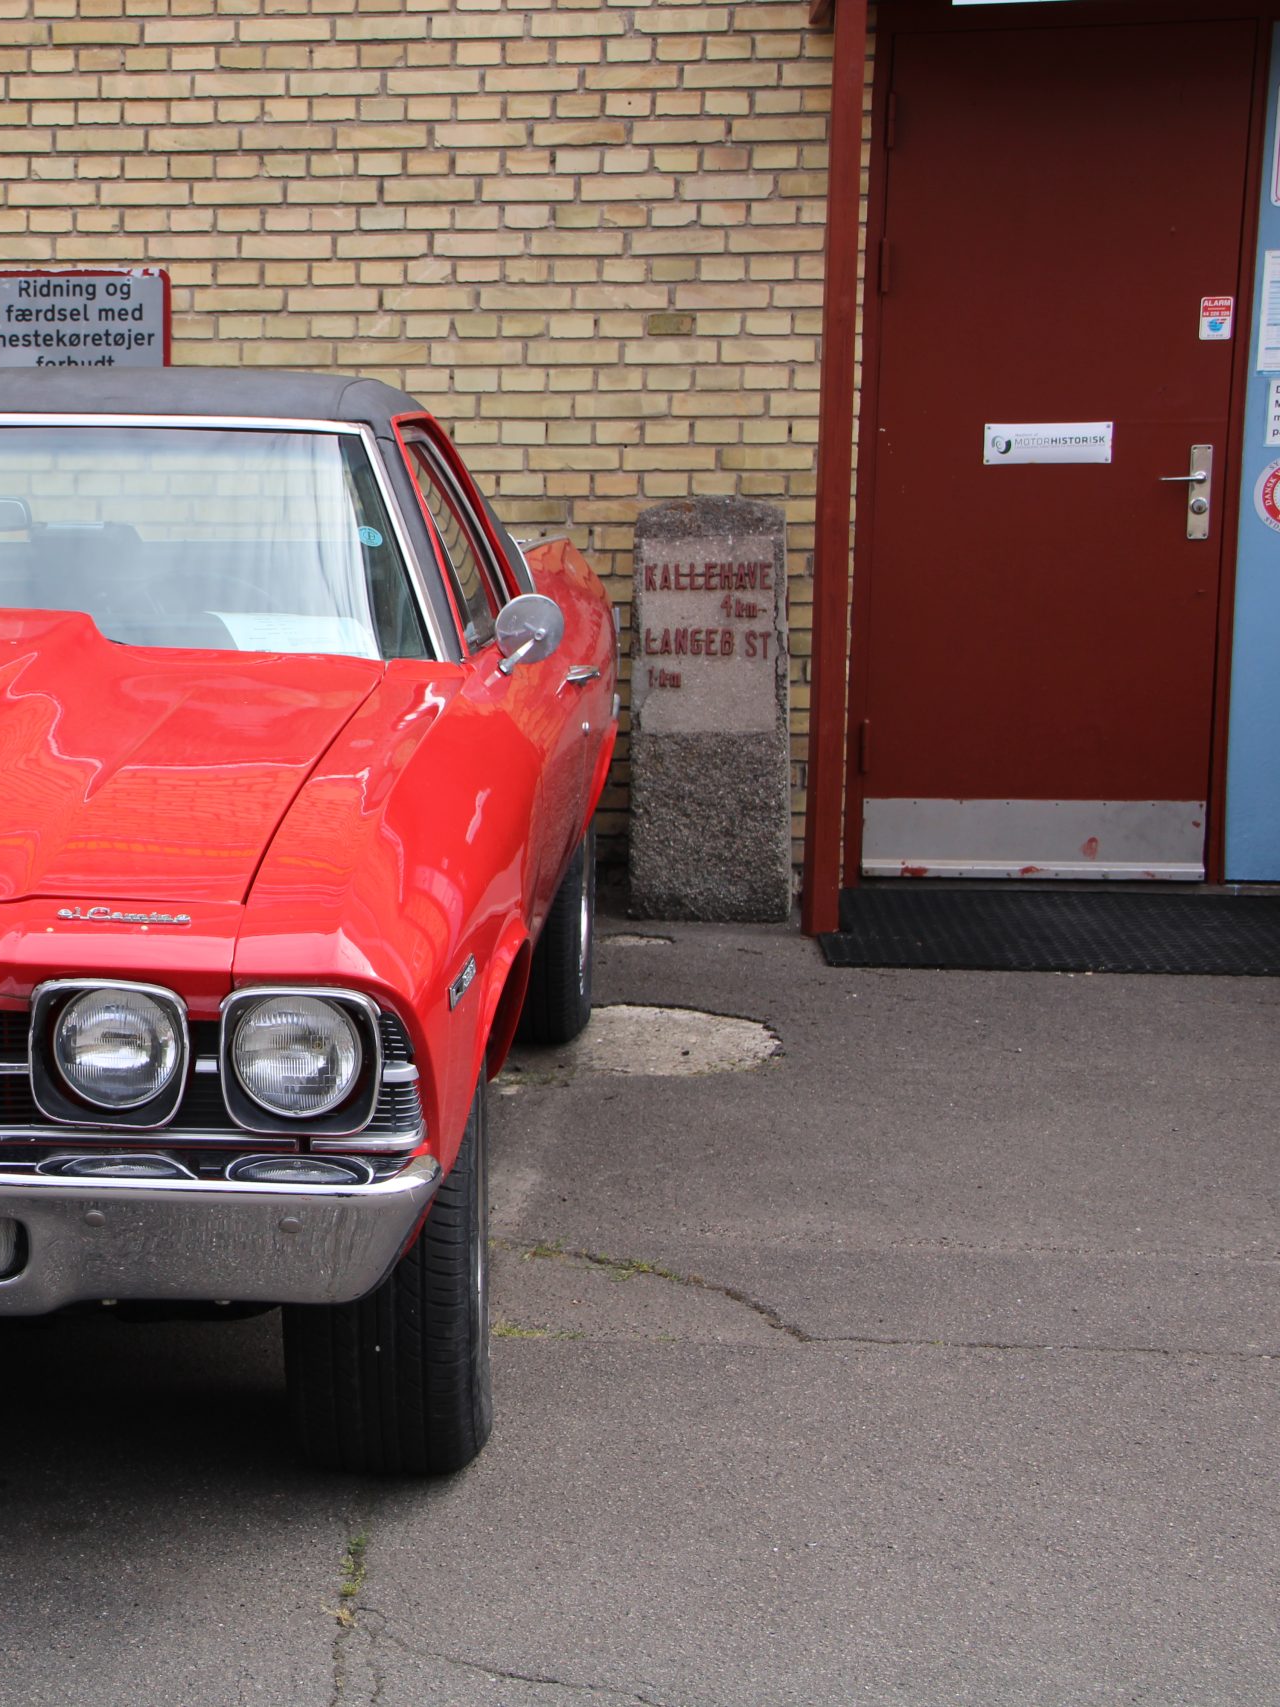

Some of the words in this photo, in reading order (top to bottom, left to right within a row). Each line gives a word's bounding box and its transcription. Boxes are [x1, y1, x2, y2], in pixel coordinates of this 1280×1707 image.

[18, 280, 97, 300] Ridning
[105, 282, 132, 300] og
[5, 304, 90, 322] færdsel
[98, 303, 143, 321] med
[1202, 299, 1231, 307] ALARM
[1014, 436, 1105, 446] MOTORHISTORISK
[645, 562, 773, 591] KALLEHAVE
[720, 594, 733, 618] 4
[745, 630, 772, 659] ST
